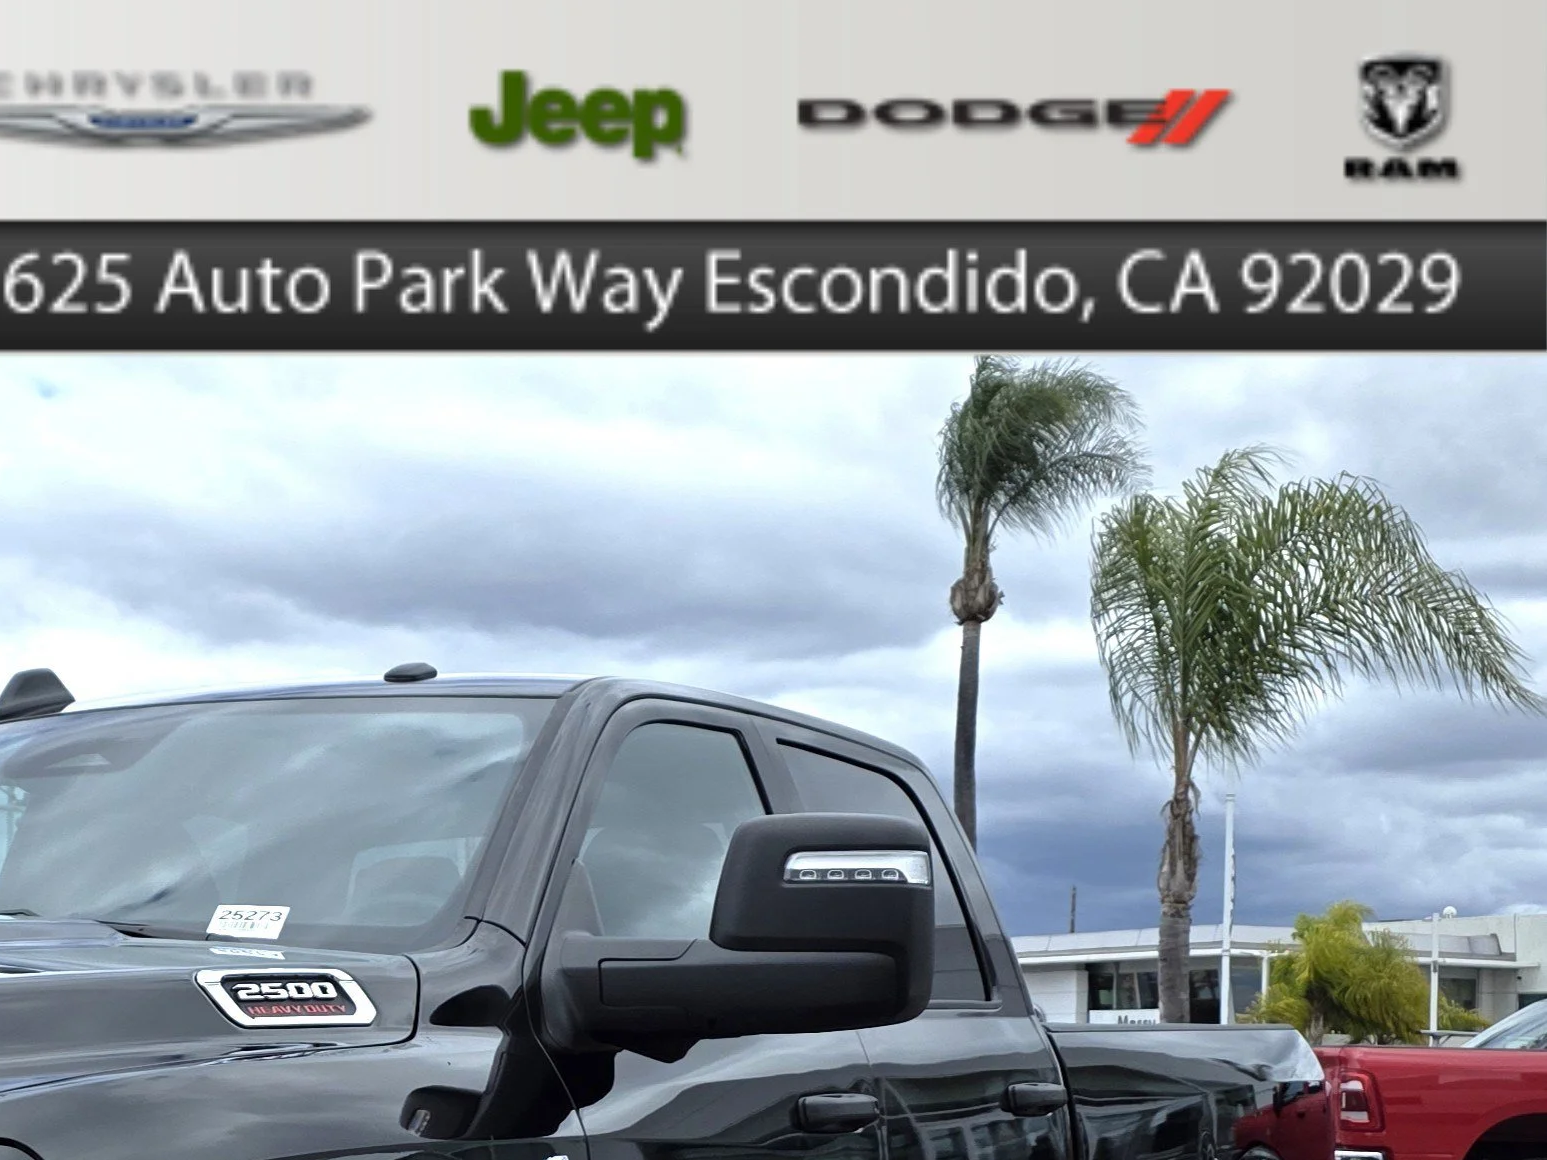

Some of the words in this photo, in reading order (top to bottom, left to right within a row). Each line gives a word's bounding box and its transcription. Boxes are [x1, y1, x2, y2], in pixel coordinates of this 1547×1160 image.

[219, 910, 283, 922] 25273
[232, 981, 338, 1001] 2500
[247, 1004, 303, 1015] HEAVY
[304, 1004, 346, 1014] DUTY
